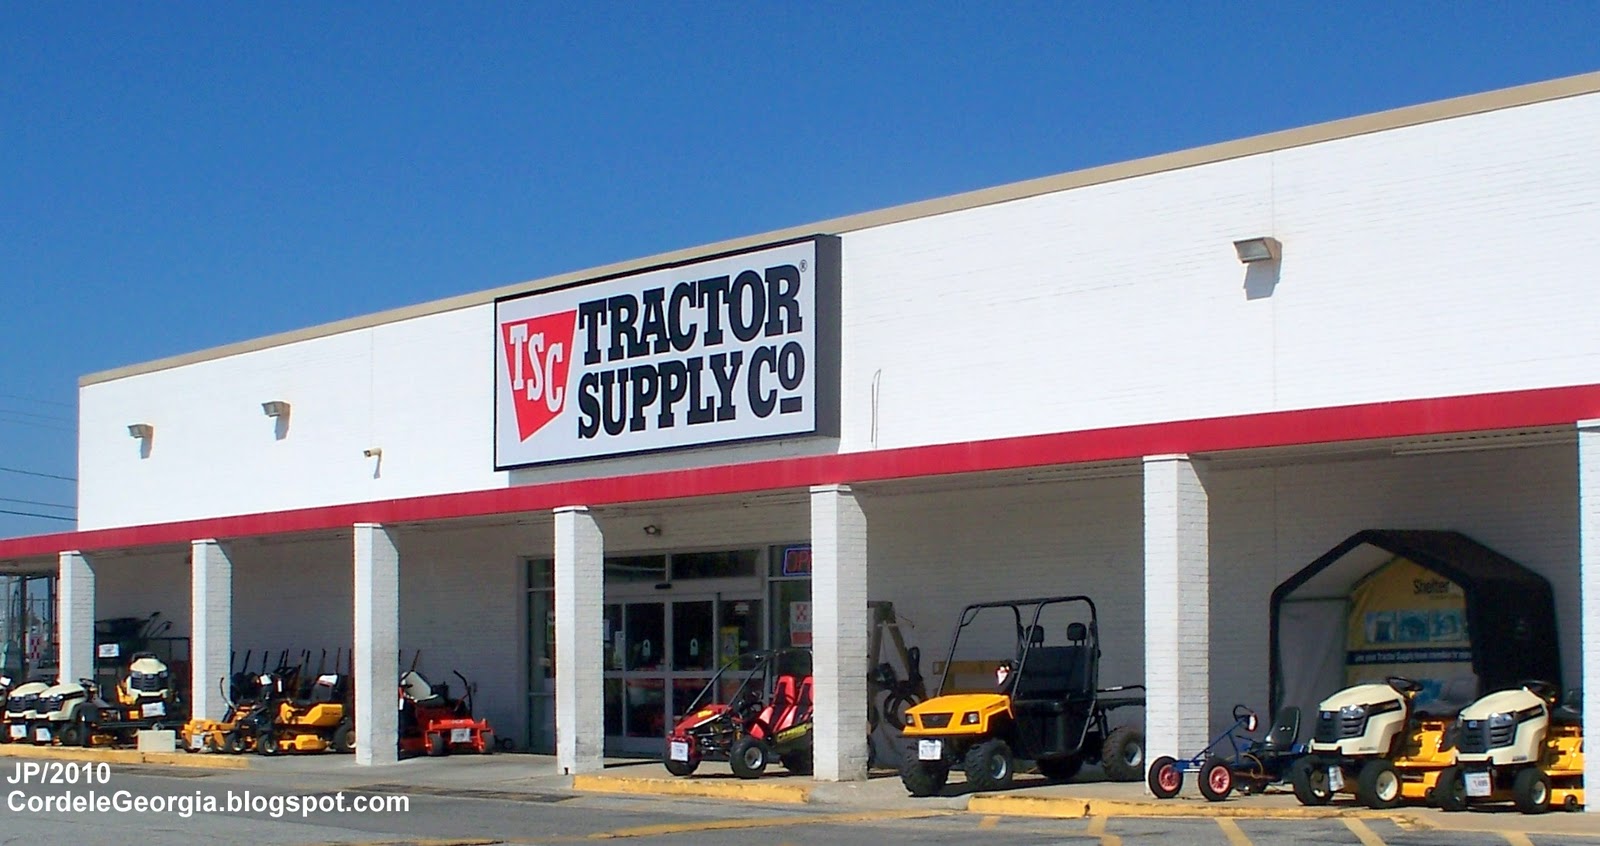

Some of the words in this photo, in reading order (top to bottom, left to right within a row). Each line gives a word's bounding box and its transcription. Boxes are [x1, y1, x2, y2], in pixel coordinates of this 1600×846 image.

[578, 264, 802, 365] TRACTOR
[510, 322, 563, 413] TSC
[578, 350, 743, 439] SUPPLY
[786, 550, 812, 573] OP
